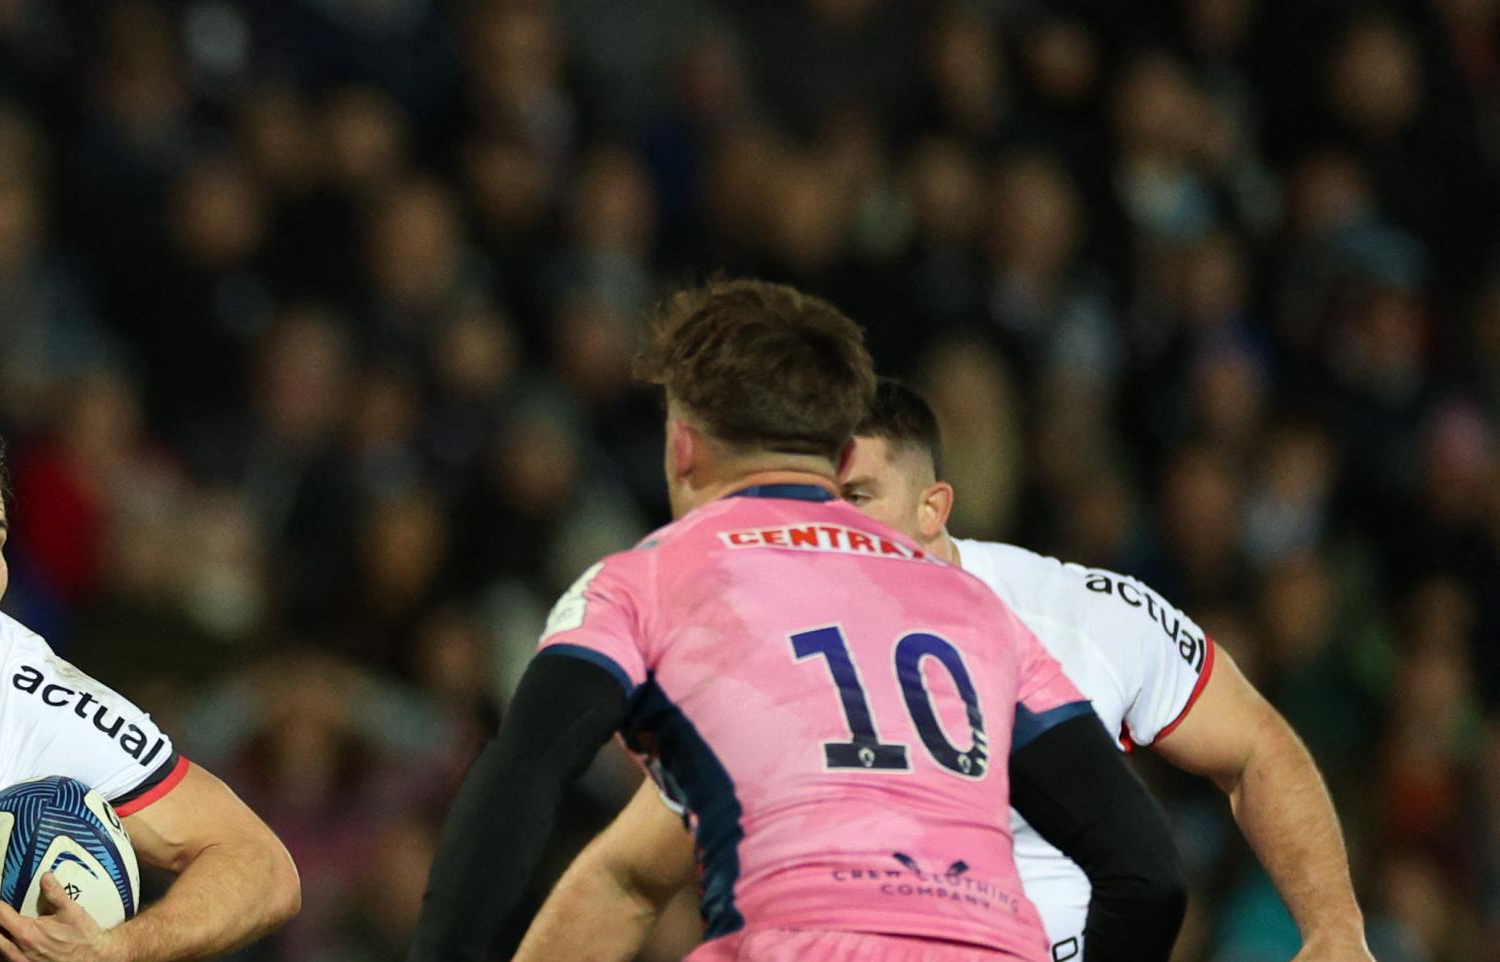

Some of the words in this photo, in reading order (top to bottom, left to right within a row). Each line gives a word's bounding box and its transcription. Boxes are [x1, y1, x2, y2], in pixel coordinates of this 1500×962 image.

[1086, 573, 1205, 674] actual
[11, 664, 166, 768] actual
[789, 625, 989, 780] 10
[881, 883, 990, 909] COMPANY
